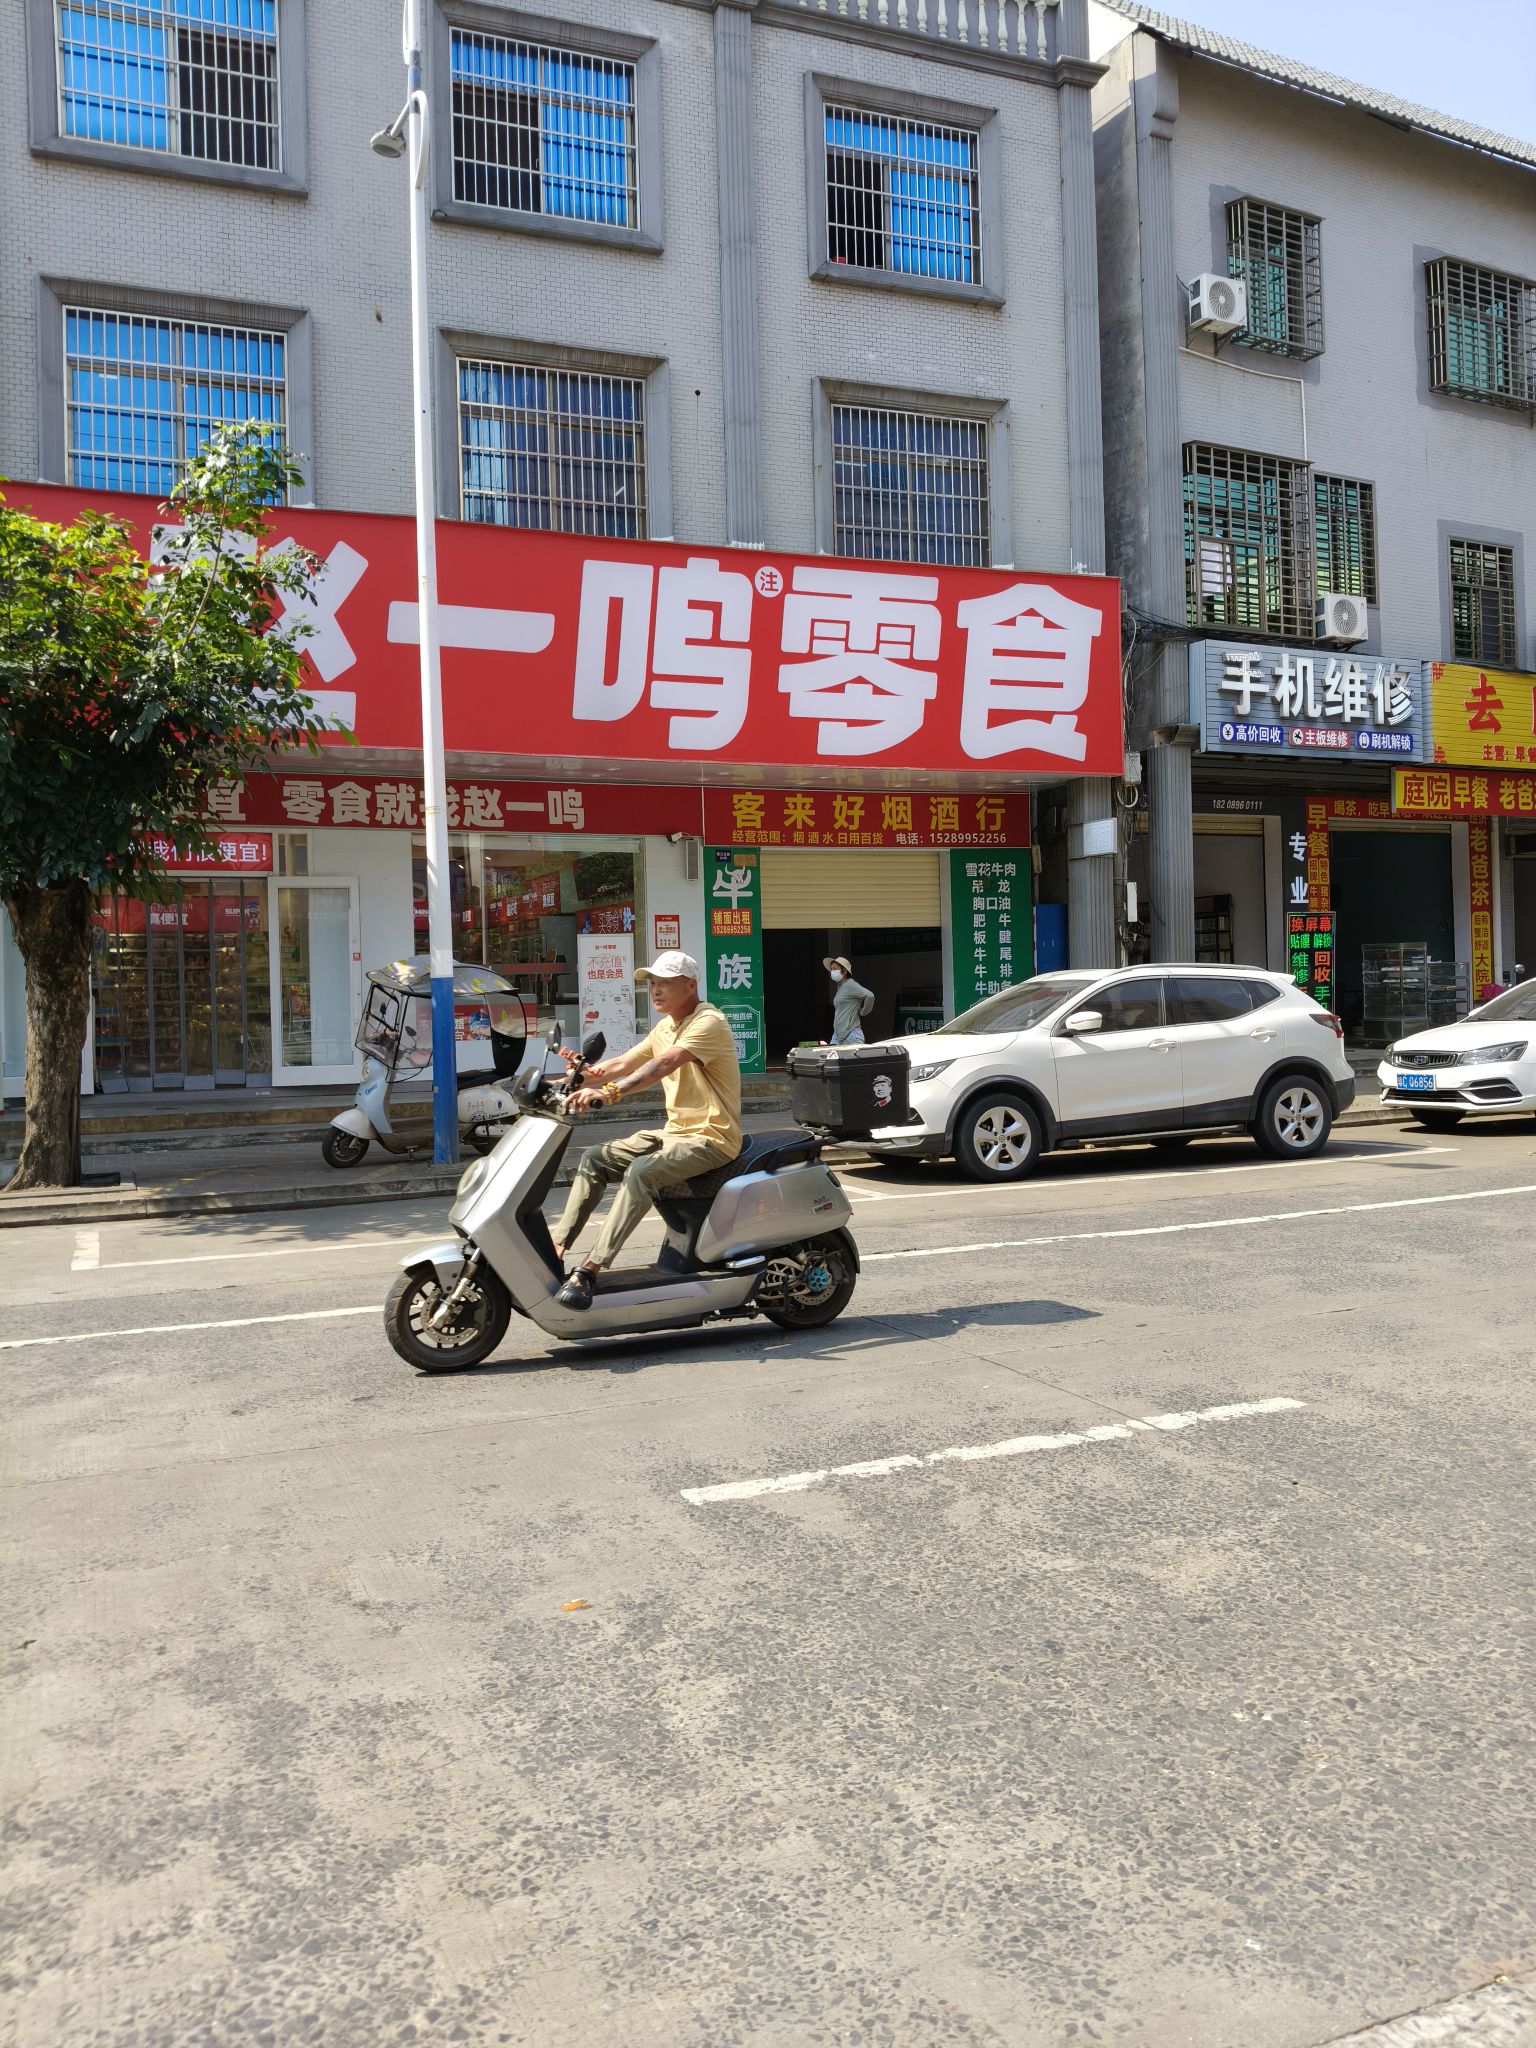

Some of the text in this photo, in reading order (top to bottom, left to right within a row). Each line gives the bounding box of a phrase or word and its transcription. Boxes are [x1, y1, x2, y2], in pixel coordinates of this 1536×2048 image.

[758, 569, 780, 593] 注
[1219, 652, 1413, 725] 手机维修
[1236, 725, 1281, 743] 高价回收
[1305, 731, 1348, 747] 主板维修
[1371, 733, 1411, 750] 刷机解锁
[1403, 774, 1536, 811] 庭院早餐 老爸
[732, 792, 1006, 831] 客来好烟酒行
[1308, 804, 1328, 857] 早餐
[965, 863, 1016, 877] 雪花牛肉
[1289, 832, 1309, 903] 专业
[1470, 827, 1489, 906] 老爸茶
[973, 897, 1011, 910] 胸口油
[714, 911, 750, 924] 铺面出租
[1291, 916, 1332, 932] 换屏幕
[1290, 934, 1310, 949] 贴膜
[974, 947, 1012, 961] 牛尾
[587, 969, 624, 980] 也是会员
[974, 964, 1013, 978] 牛排
